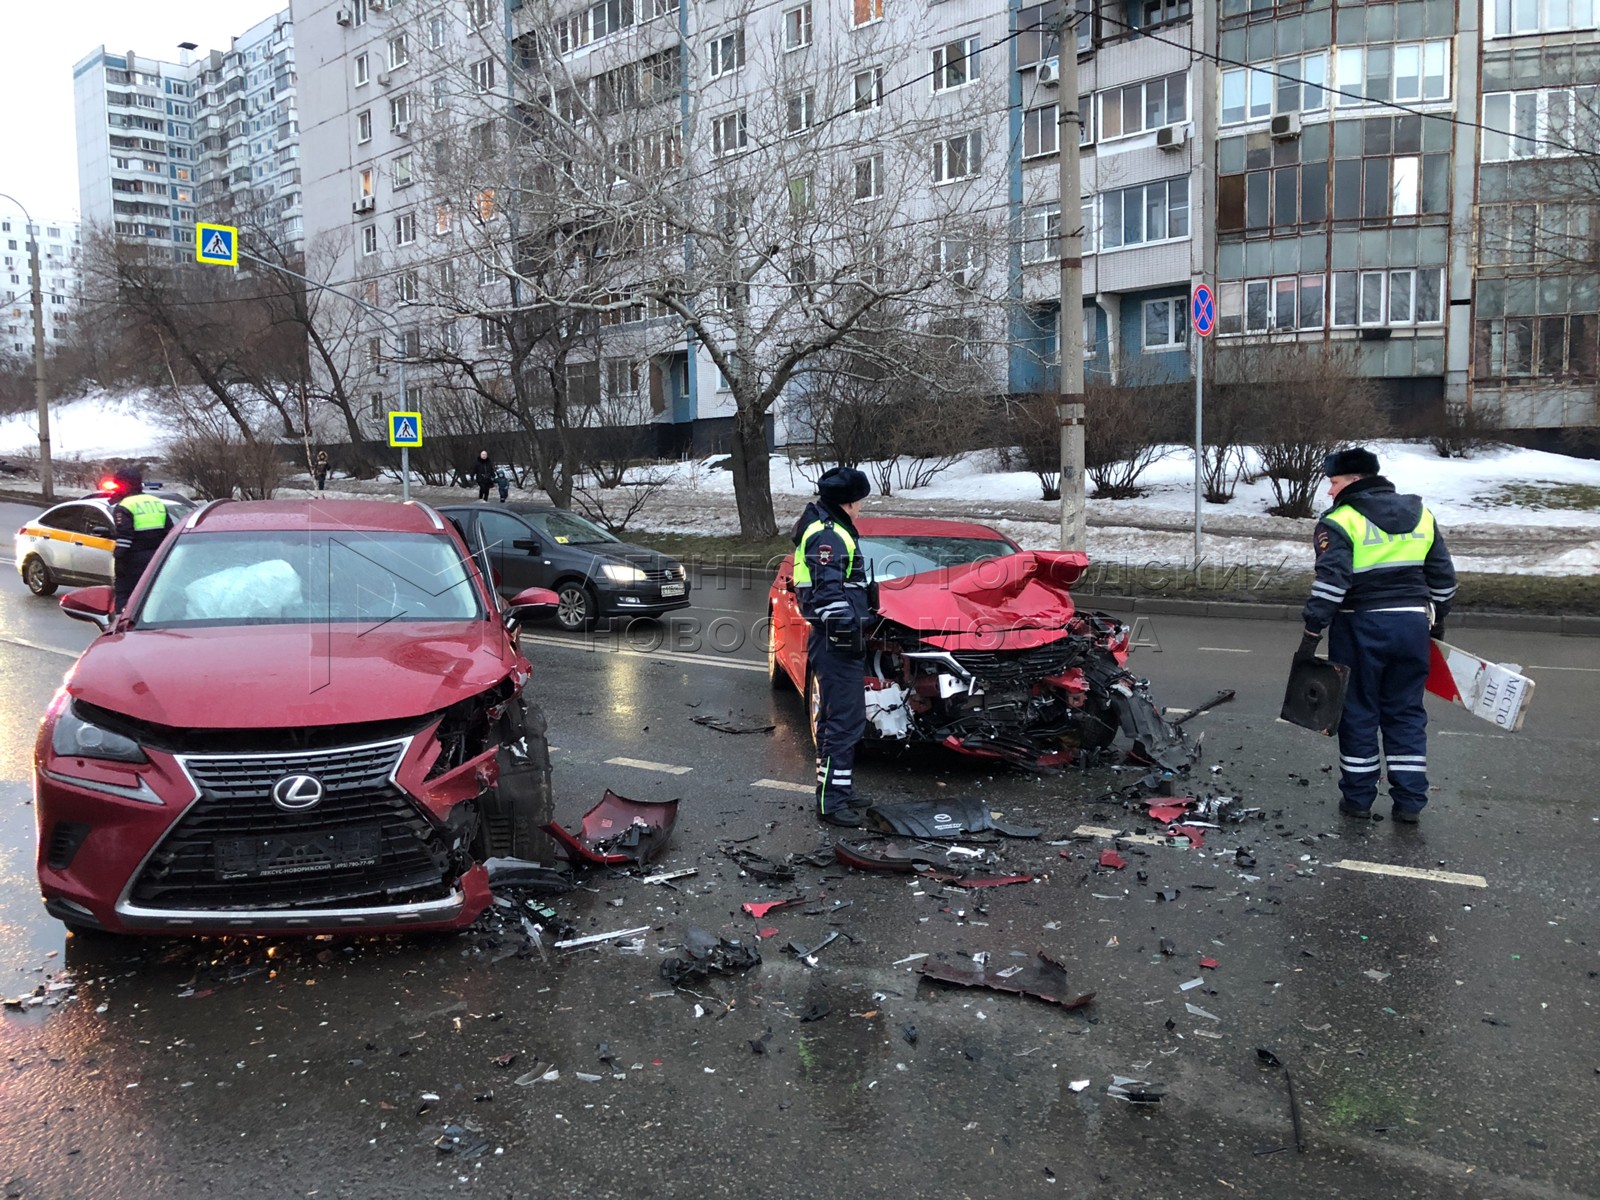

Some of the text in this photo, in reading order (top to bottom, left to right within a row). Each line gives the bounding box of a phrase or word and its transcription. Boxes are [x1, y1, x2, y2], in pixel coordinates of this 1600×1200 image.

[135, 501, 165, 515] ДПС
[1482, 678, 1500, 708] ДТП
[1495, 676, 1520, 725] МЕСТО
